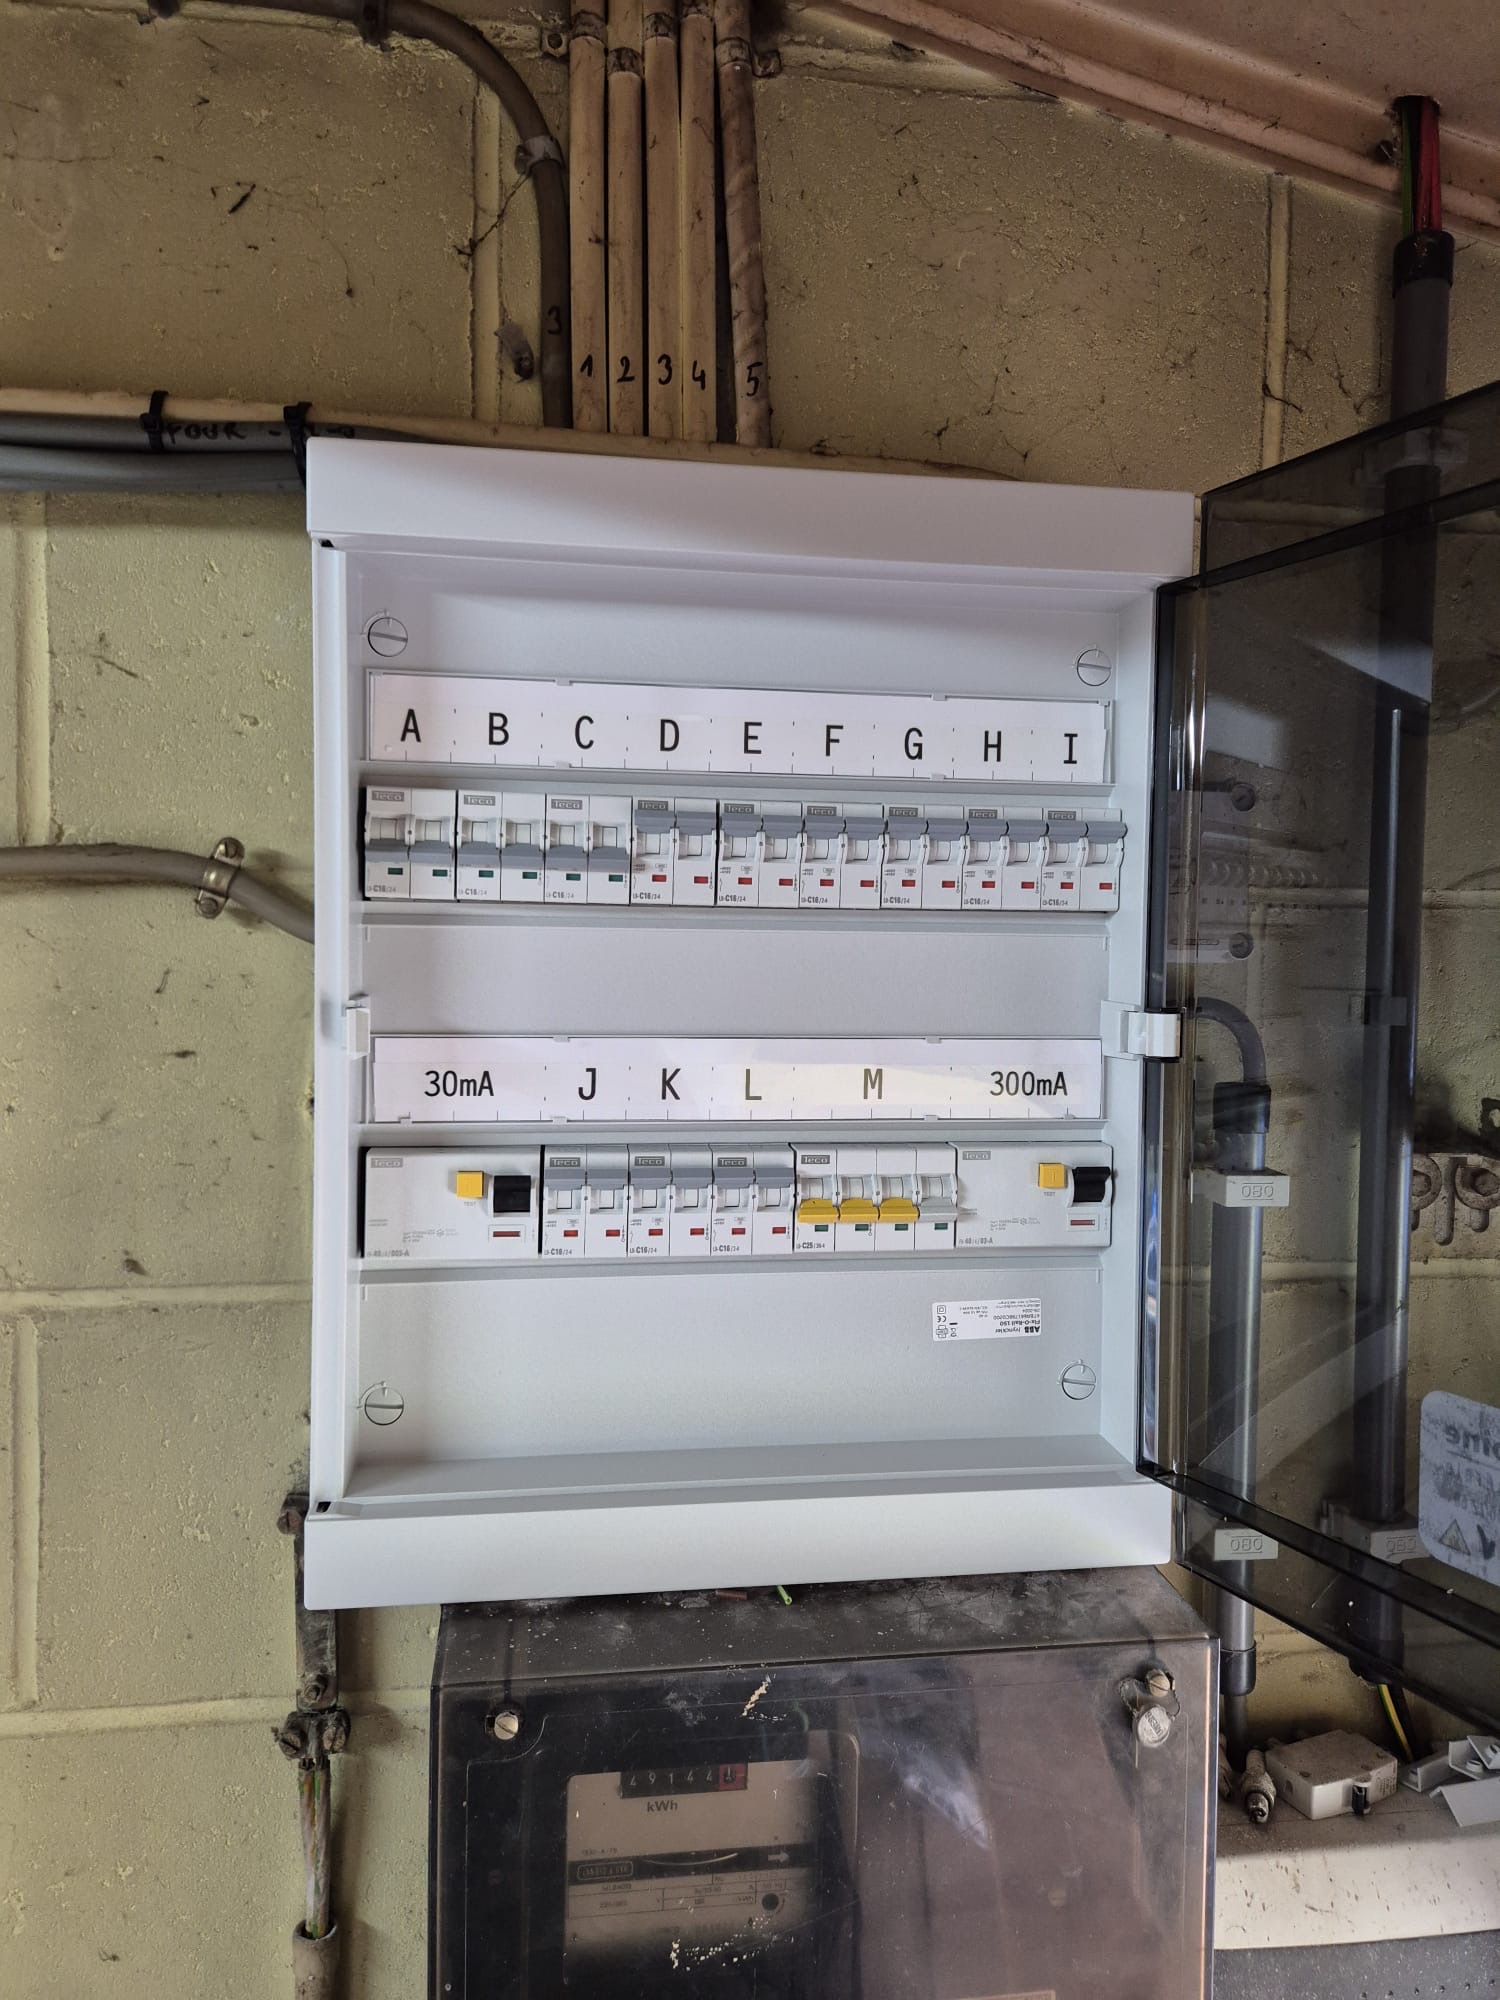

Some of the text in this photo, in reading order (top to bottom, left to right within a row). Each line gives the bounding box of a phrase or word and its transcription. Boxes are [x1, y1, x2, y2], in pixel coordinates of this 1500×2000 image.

[580, 354, 593, 377] 1
[616, 356, 635, 383] 2
[657, 353, 673, 385] 3
[692, 360, 706, 390] 4
[746, 361, 764, 396] 5
[400, 708, 421, 742] A
[489, 712, 510, 745] B
[575, 715, 595, 750] C
[659, 719, 681, 751] D
[744, 721, 762, 754] E
[825, 725, 844, 756] F
[904, 728, 923, 760] G
[983, 731, 1001, 762] H
[1063, 733, 1078, 764] I
[424, 1070, 495, 1097] 30mA
[578, 1068, 597, 1101] J
[661, 1068, 681, 1100] K
[745, 1068, 762, 1100] L
[863, 1068, 883, 1099] M
[989, 1071, 1068, 1096] 300mA
[647, 1800, 678, 1812] kWh
